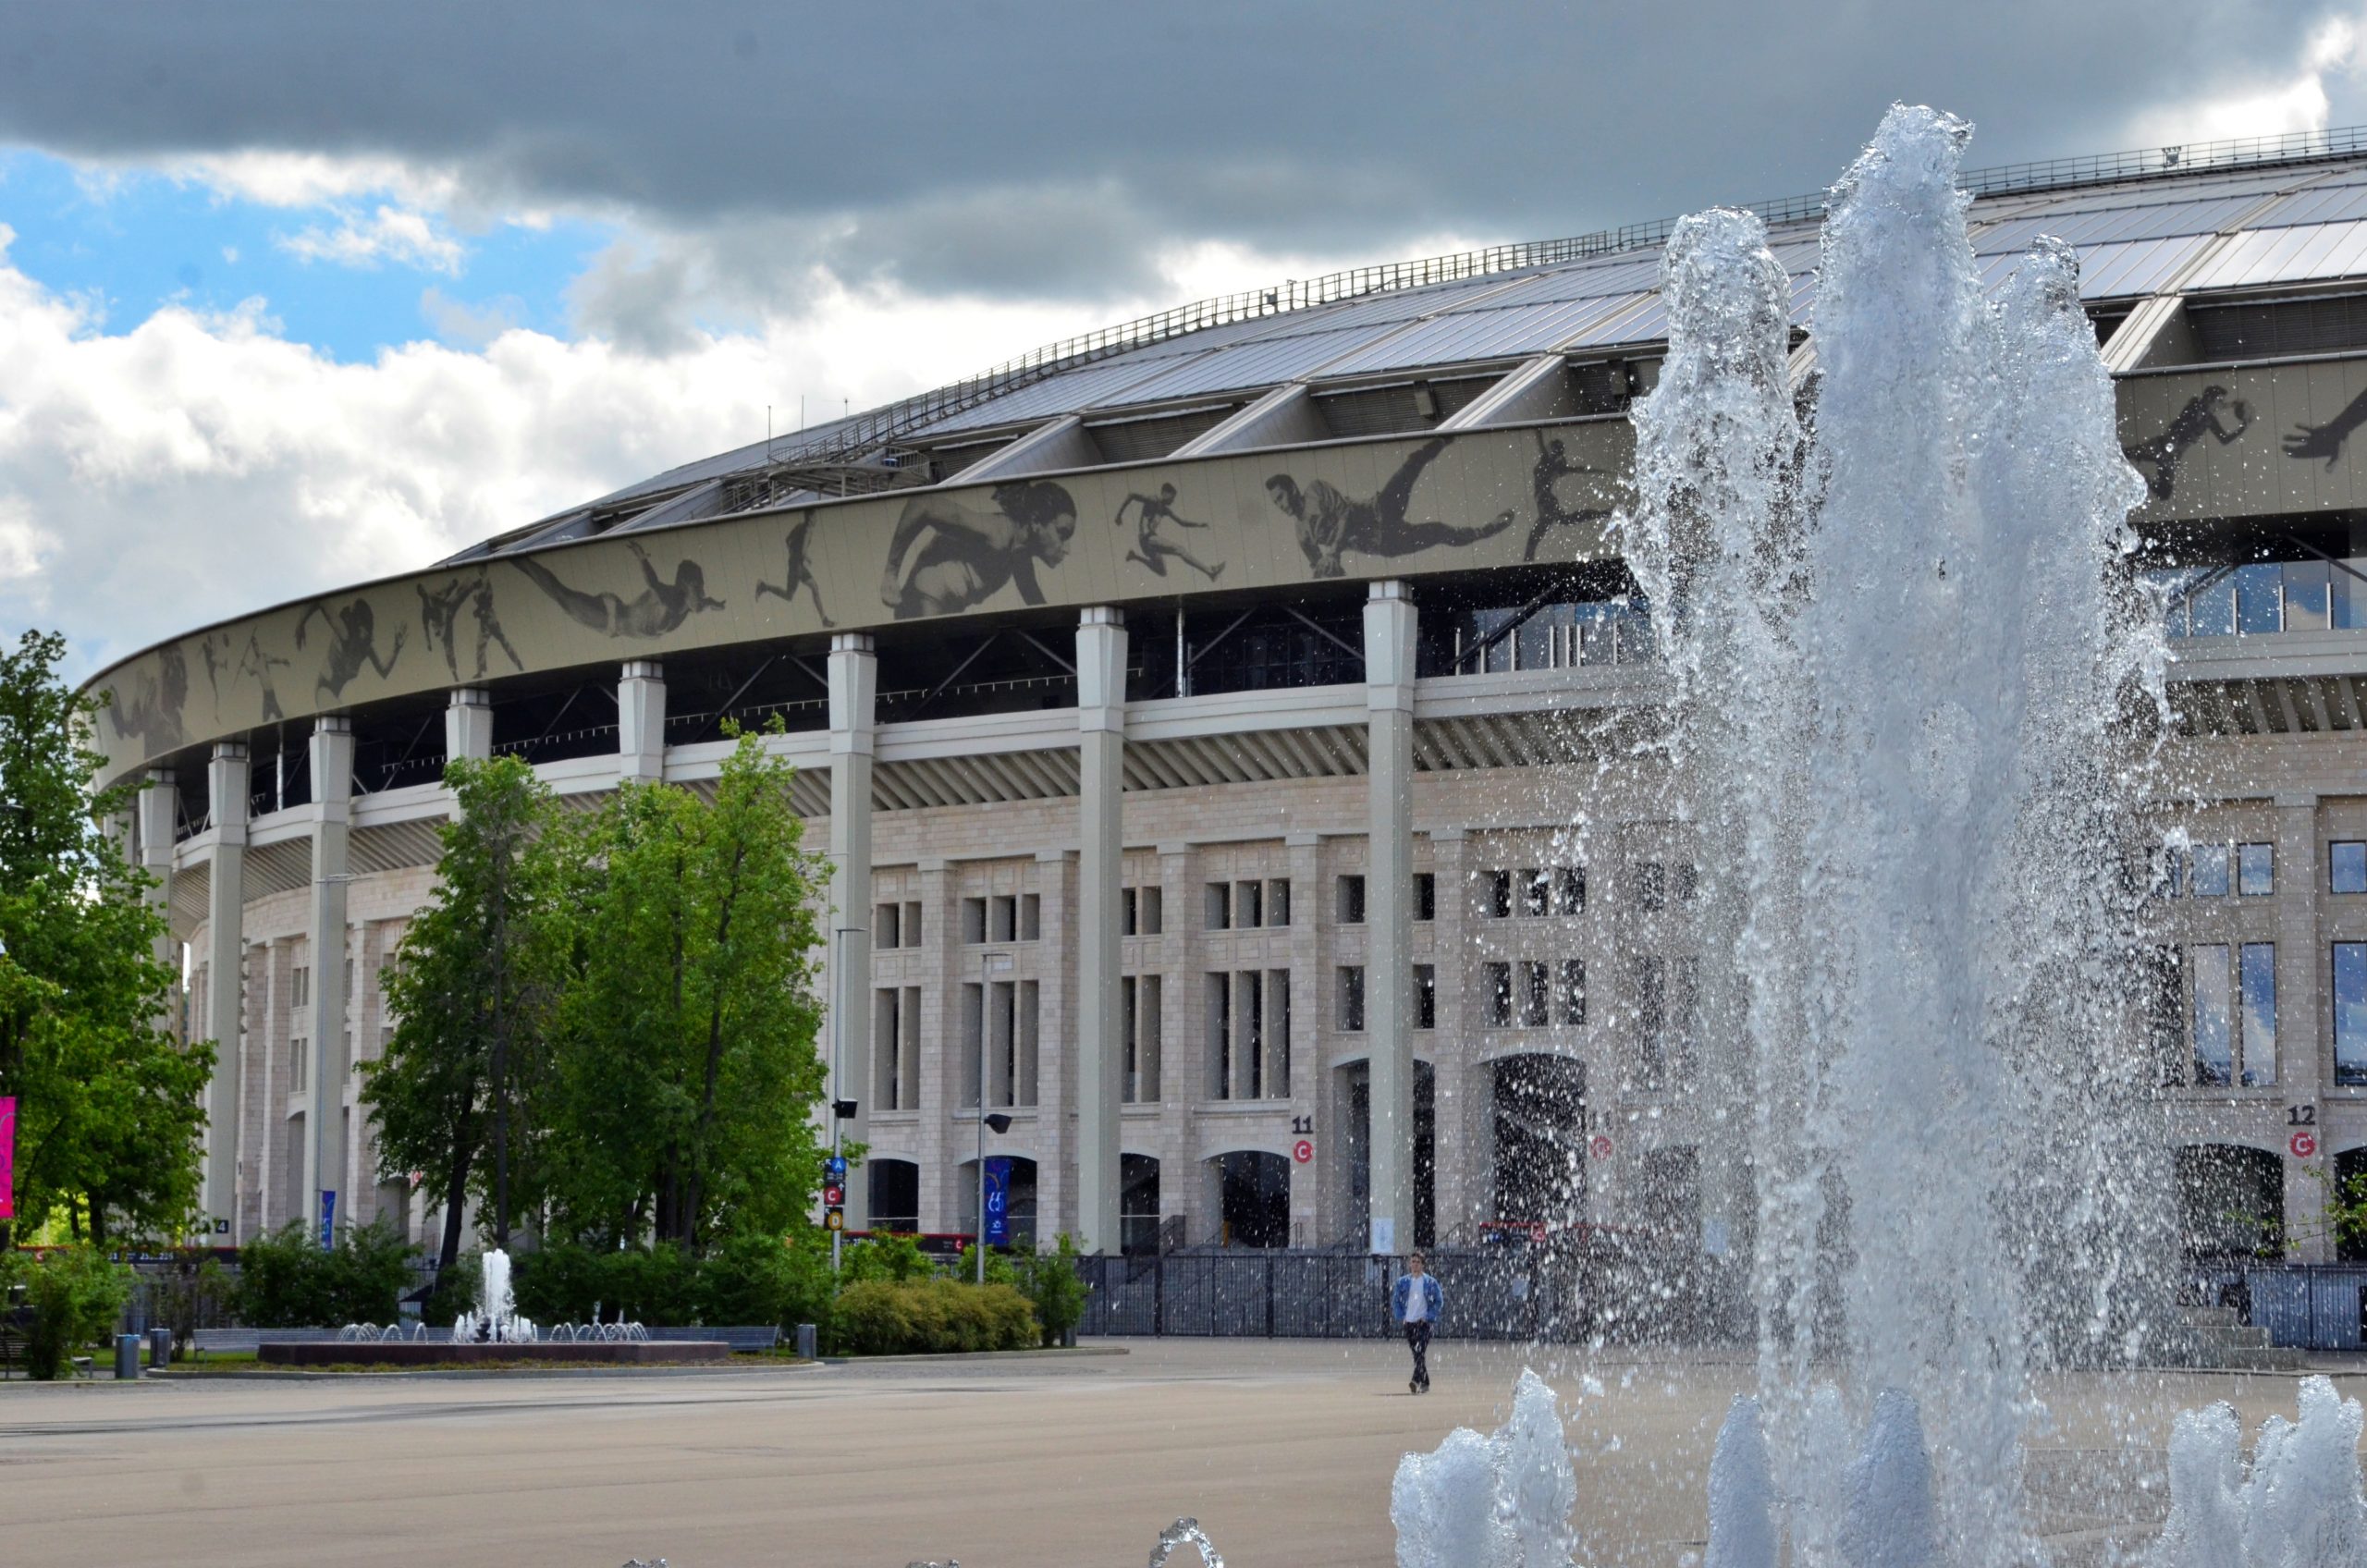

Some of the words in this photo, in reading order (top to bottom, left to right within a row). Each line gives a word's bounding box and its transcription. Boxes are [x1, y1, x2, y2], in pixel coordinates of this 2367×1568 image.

[2287, 1106, 2315, 1125] 12
[1292, 1115, 1314, 1134] 11
[2296, 1137, 2308, 1152] C
[1298, 1145, 1307, 1158] C
[835, 1160, 842, 1170] A
[828, 1190, 836, 1201] C
[217, 1221, 226, 1231] 4
